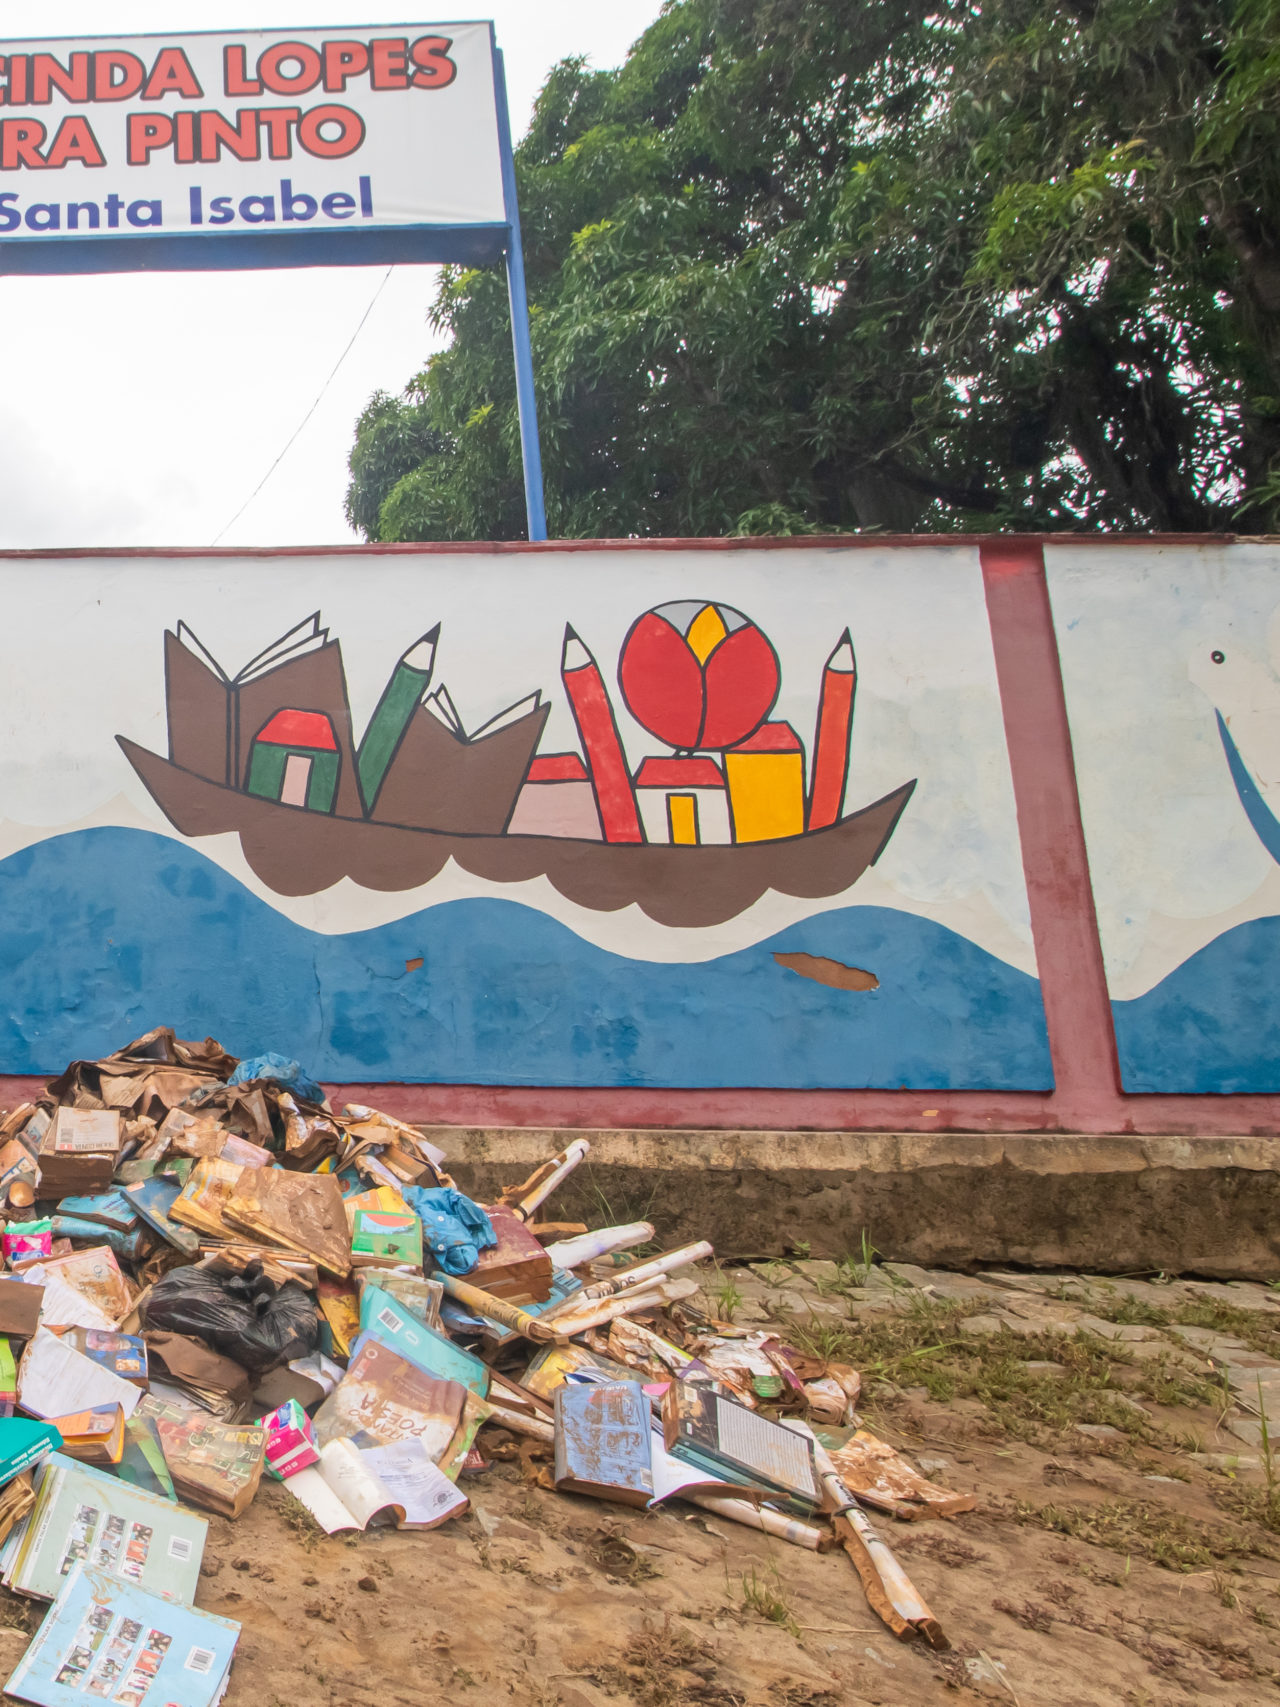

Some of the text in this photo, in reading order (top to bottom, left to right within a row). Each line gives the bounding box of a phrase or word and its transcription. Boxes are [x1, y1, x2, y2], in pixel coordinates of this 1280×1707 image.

[223, 35, 457, 97] LOPES
[127, 103, 366, 166] PINTO
[189, 175, 374, 225] Isabel
[11, 1437, 51, 1465] Educação Básica
